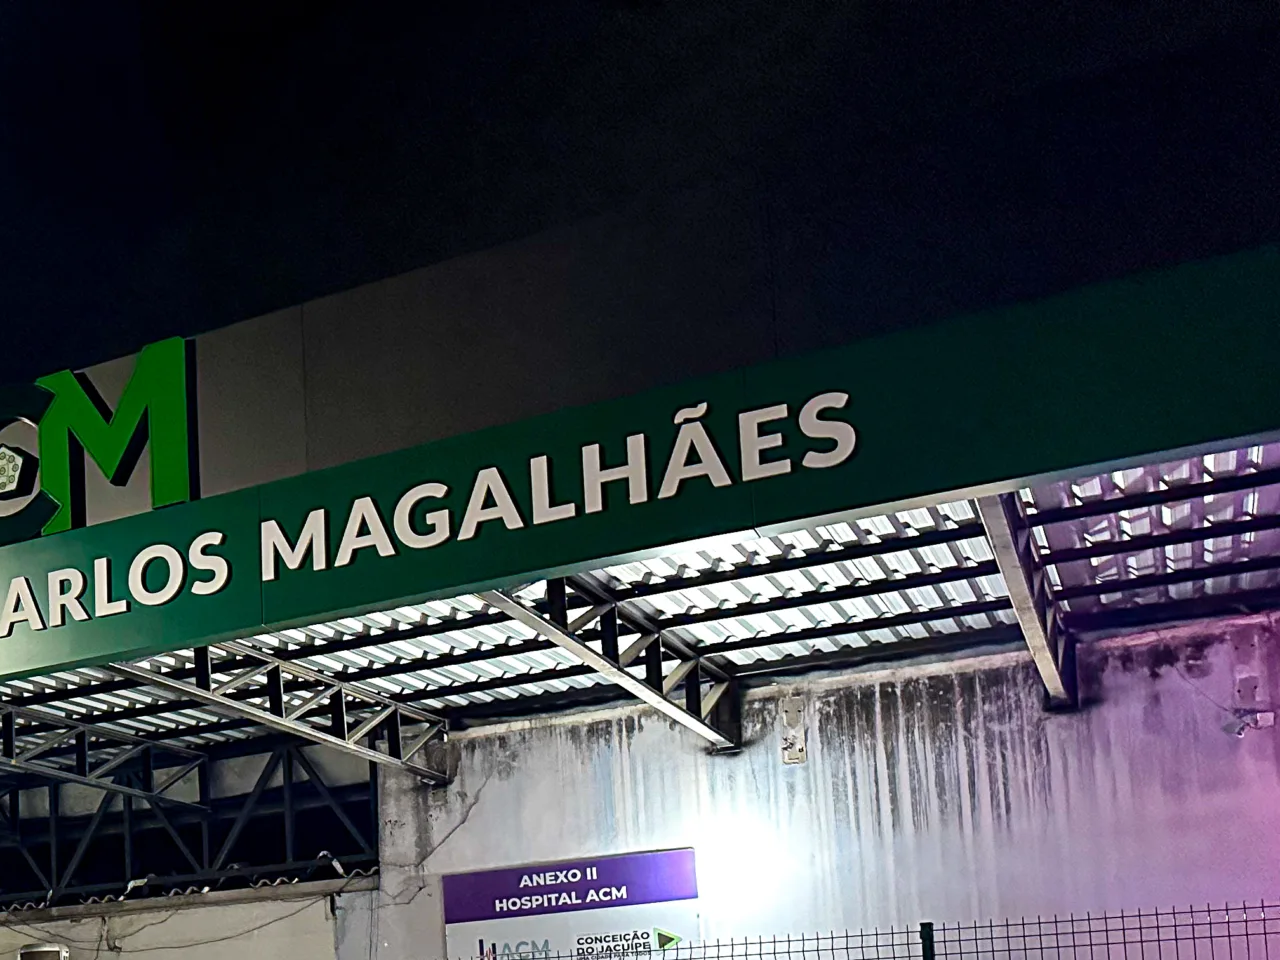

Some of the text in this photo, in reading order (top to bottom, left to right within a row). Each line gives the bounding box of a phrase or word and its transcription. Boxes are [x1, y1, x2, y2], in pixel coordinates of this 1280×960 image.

[261, 391, 860, 583] MAGALHÃES
[519, 867, 598, 888] ANEXO II
[495, 886, 627, 912] HOSPITAL ACM
[577, 931, 650, 945] CONCEIÇÃO
[577, 940, 651, 956] DO JACUÍPE
